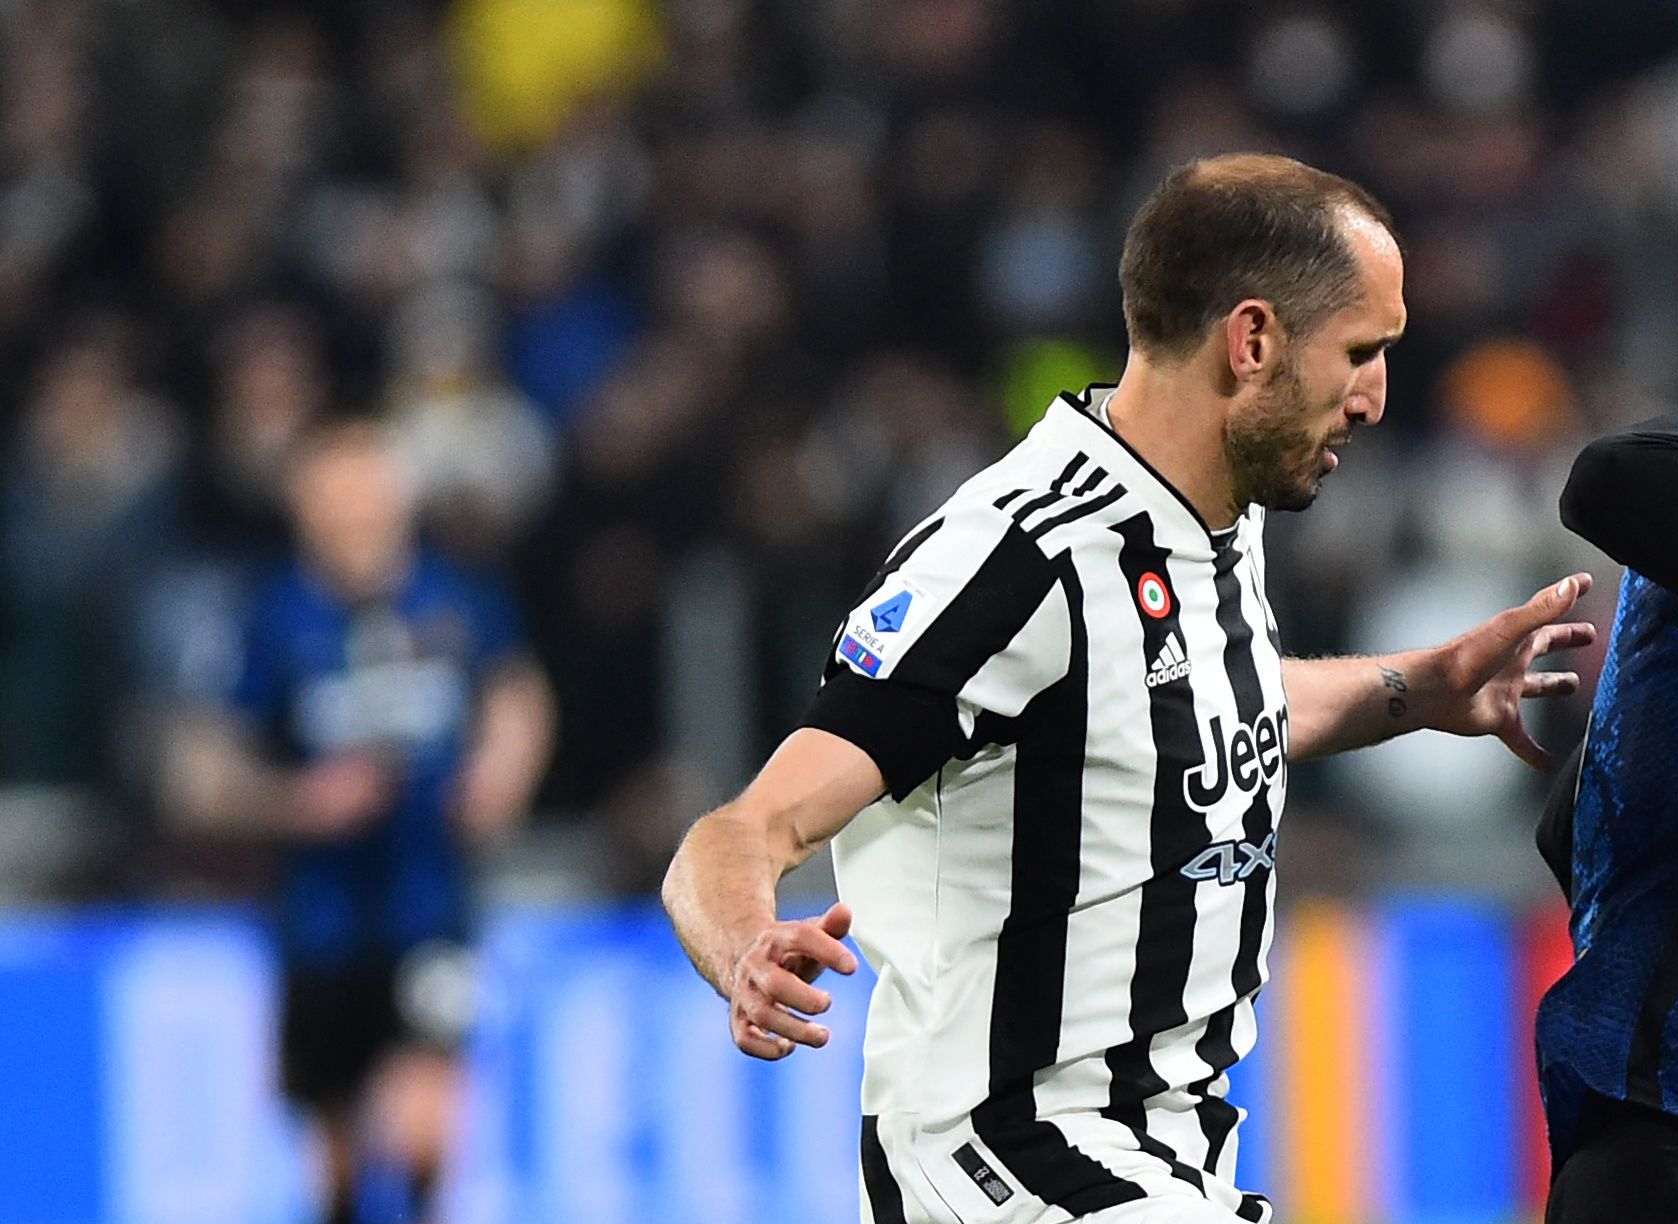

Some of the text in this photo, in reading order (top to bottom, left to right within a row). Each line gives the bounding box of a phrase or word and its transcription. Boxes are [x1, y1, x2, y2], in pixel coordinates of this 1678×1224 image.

[853, 625, 885, 654] SERIE A
[1145, 660, 1192, 688] adidas
